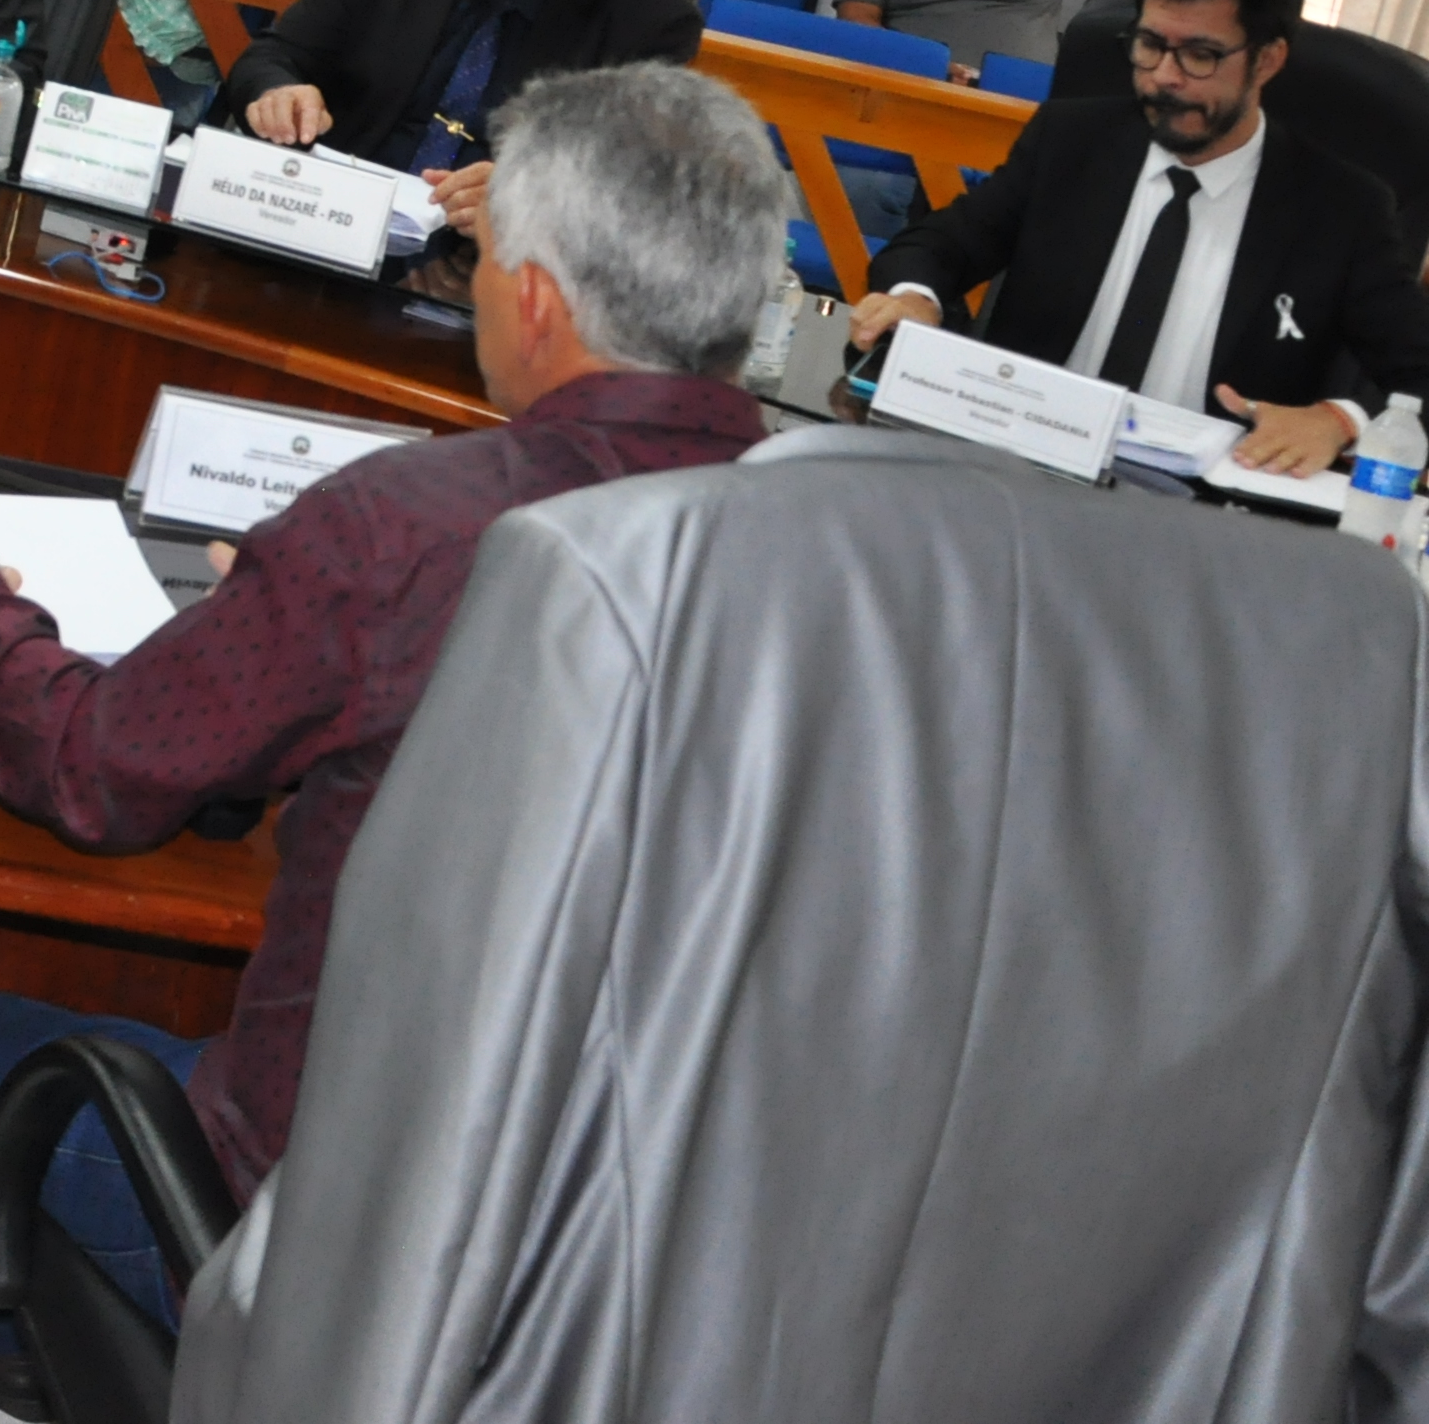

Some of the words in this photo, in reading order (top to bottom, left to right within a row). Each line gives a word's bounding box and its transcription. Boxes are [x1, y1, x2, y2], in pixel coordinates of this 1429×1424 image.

[211, 177, 246, 198] HÉLIO
[248, 188, 266, 204] DA
[269, 193, 318, 218] NAZARÉ
[327, 208, 354, 226] PSD
[190, 463, 257, 489] Nivaldo
